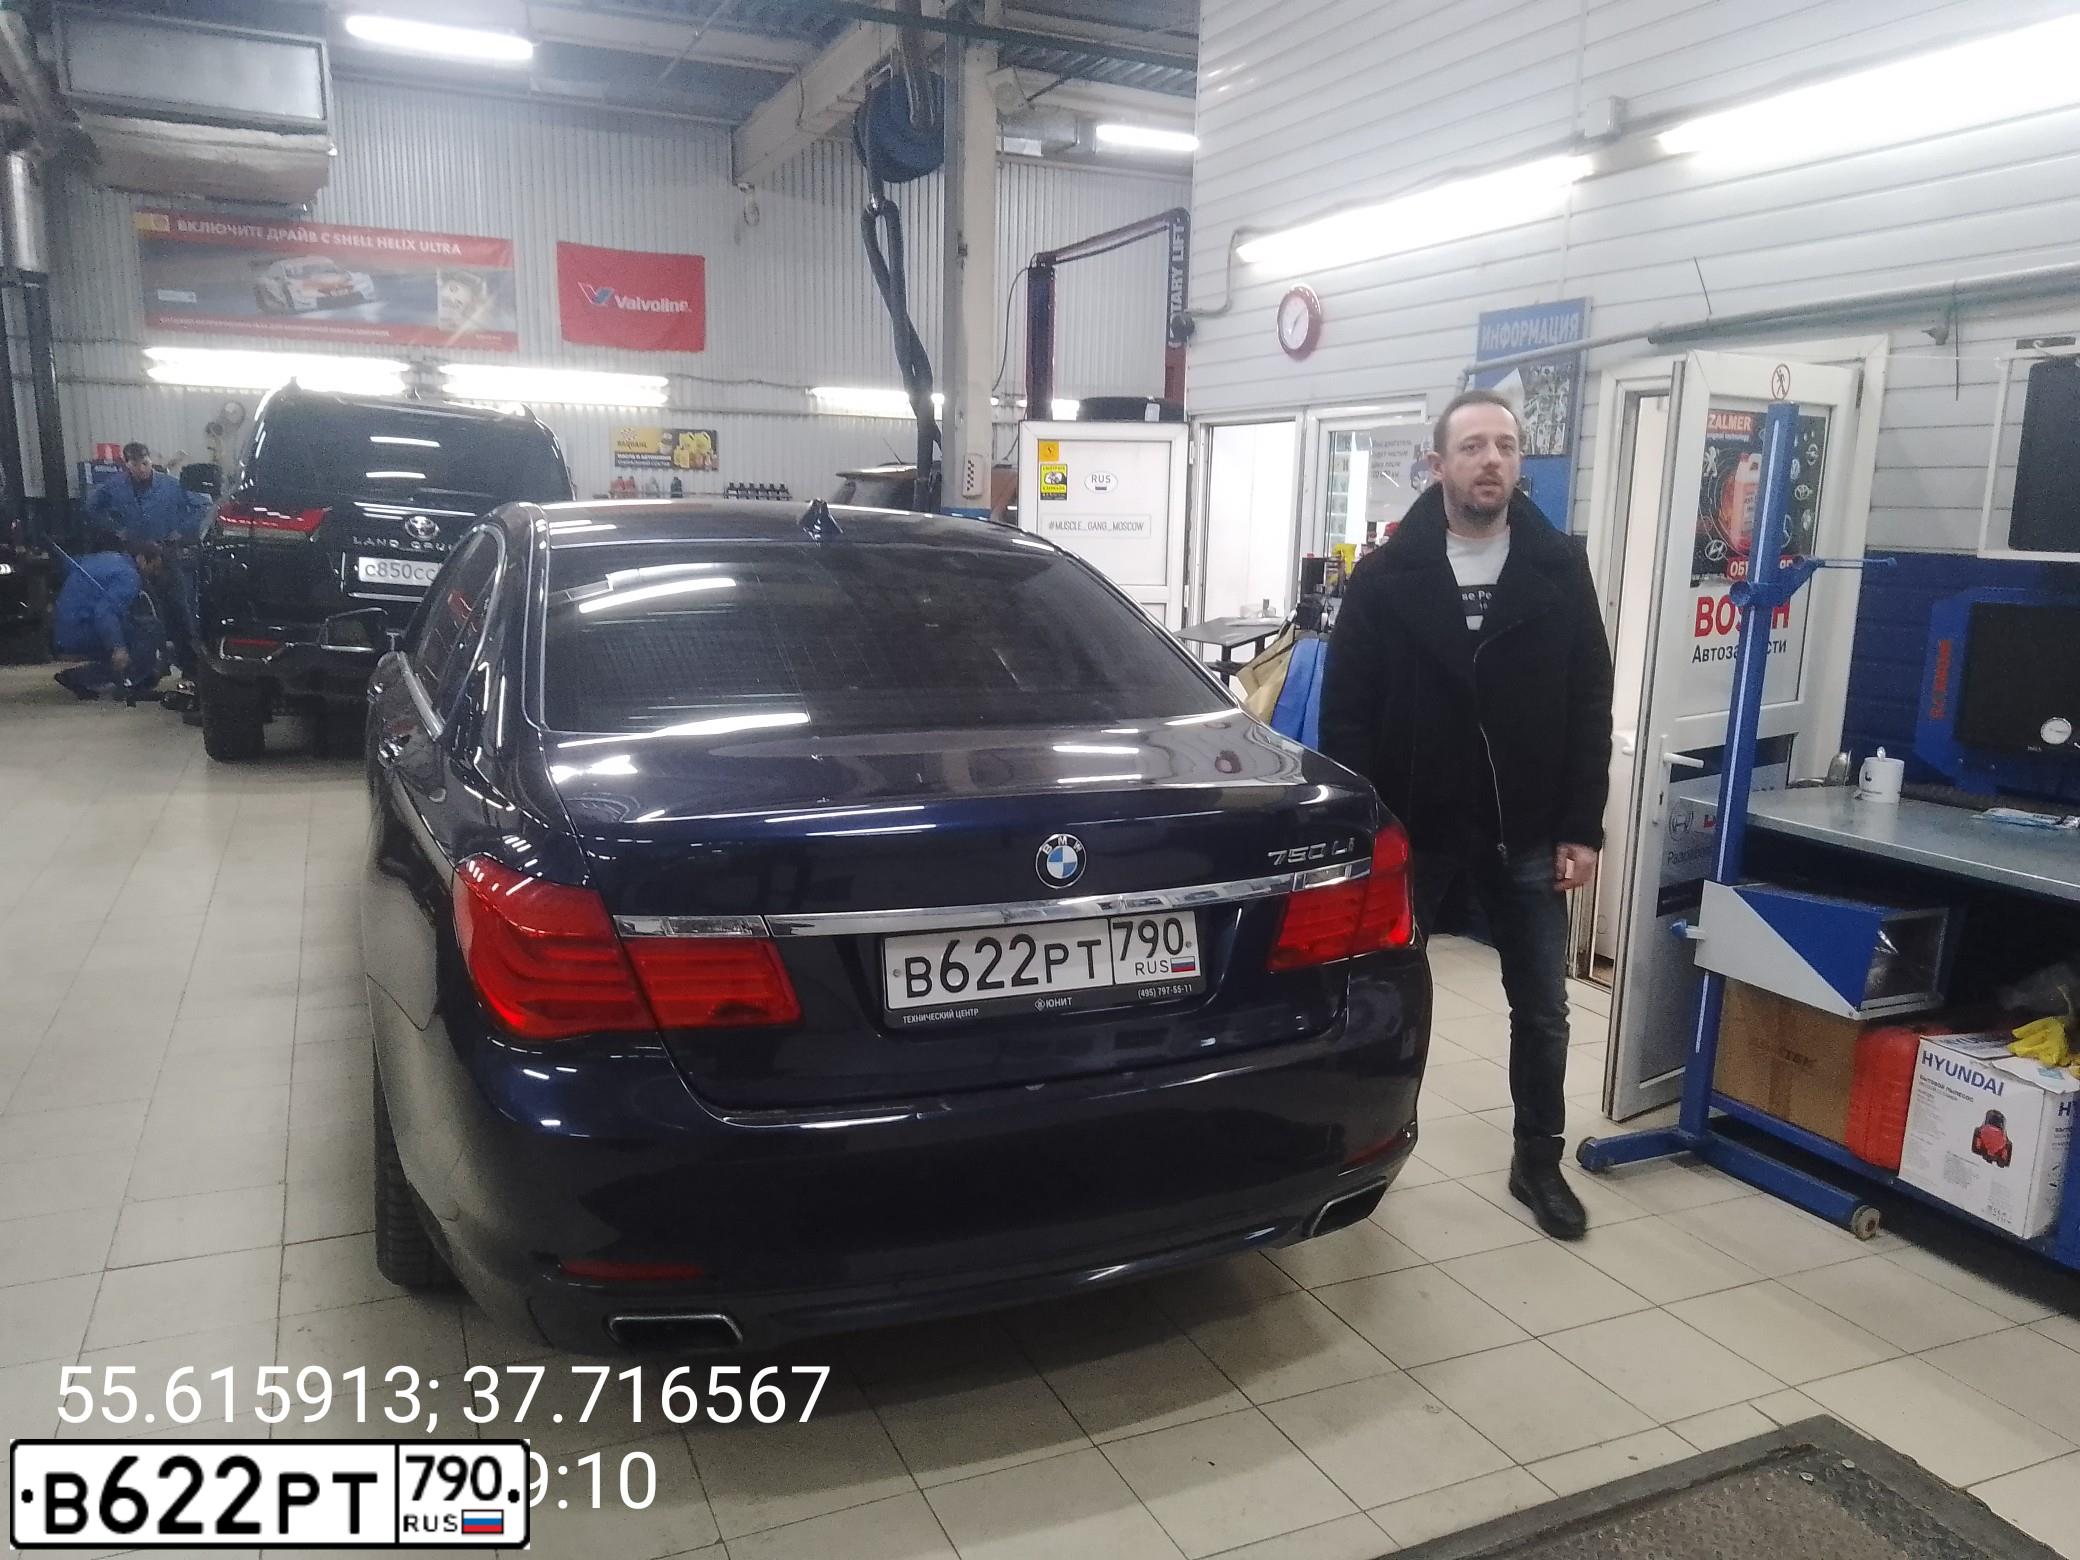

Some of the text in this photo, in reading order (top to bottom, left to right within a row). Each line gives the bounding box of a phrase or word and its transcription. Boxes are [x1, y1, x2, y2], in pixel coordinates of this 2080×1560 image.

[177, 219, 264, 238] ВКЛЮЧИТЕ
[266, 227, 318, 243] ДРАЙВ
[334, 233, 374, 247] SHELL
[377, 237, 416, 251] HELIX
[419, 241, 462, 256] ULTRA
[1171, 223, 1185, 262] LIFT
[1480, 312, 1580, 350] ИНФОРМАЦИЯ
[1708, 413, 1752, 431] ZALMER
[1091, 474, 1111, 484] RUS
[352, 535, 400, 548] LAND
[1694, 594, 1790, 637] BOH
[1691, 639, 1787, 664] Автозсти
[1042, 836, 1082, 855] BMW
[904, 917, 1184, 999] В622РТ 790
[1134, 959, 1169, 976] RUS
[1137, 984, 1193, 1000] (495) 797-55-11
[902, 997, 1073, 1024] ТЕХНИЧЕСКИЙ ЦЕНТР ЮНИТ
[1921, 1050, 2005, 1097] HYUNDAI
